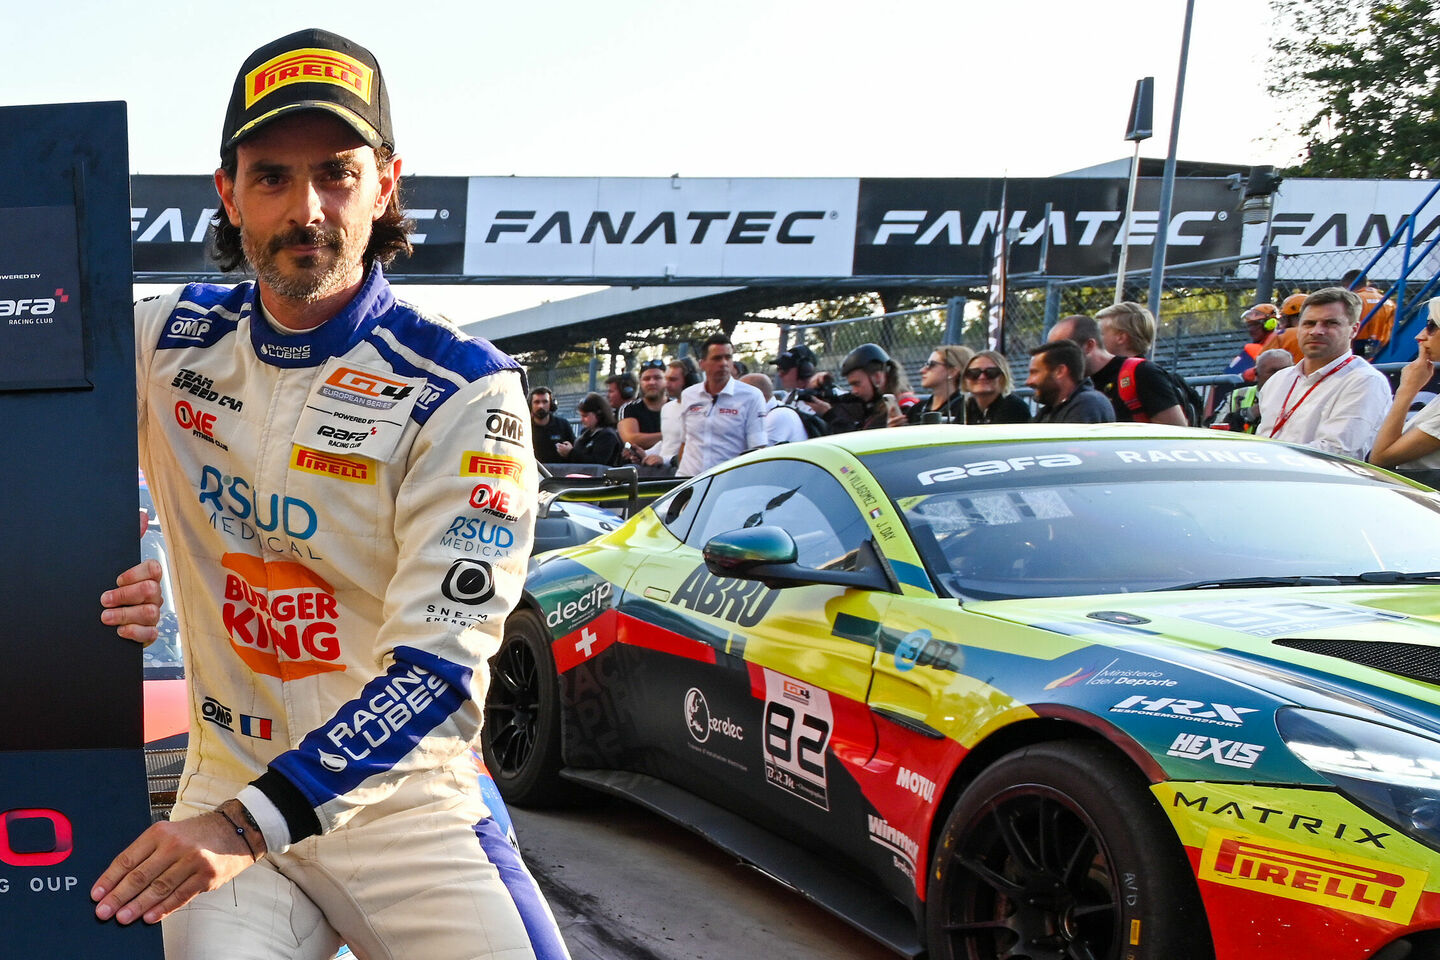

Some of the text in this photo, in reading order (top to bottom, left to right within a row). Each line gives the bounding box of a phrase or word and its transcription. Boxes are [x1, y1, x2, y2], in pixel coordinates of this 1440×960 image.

[254, 54, 363, 96] PIRELLI
[8, 317, 54, 326] RACING CLUB
[171, 320, 210, 337] OMP
[267, 344, 311, 352] RACING
[267, 351, 311, 360] LUBES
[177, 368, 214, 390] TEAM
[171, 377, 244, 413] SPEED CAR
[322, 387, 366, 405] EUROPEAN
[418, 387, 441, 406] MP
[333, 411, 367, 425] POWERED
[486, 413, 524, 441] OMP
[328, 440, 349, 449] RACING
[1115, 449, 1266, 465] RACING
[296, 449, 367, 479] PIRELLI
[225, 574, 339, 622] BURGER
[547, 582, 611, 628] decip
[223, 602, 341, 661] KING
[1092, 676, 1178, 688] del Deporte
[1100, 668, 1164, 679] Ministerio
[202, 702, 232, 727] OMP
[1111, 695, 1261, 724] HRX
[1166, 733, 1265, 769] HEXIS
[896, 766, 936, 804] MOTUL
[1173, 791, 1391, 850] MATRIX
[1214, 838, 1406, 910] PIRELLI
